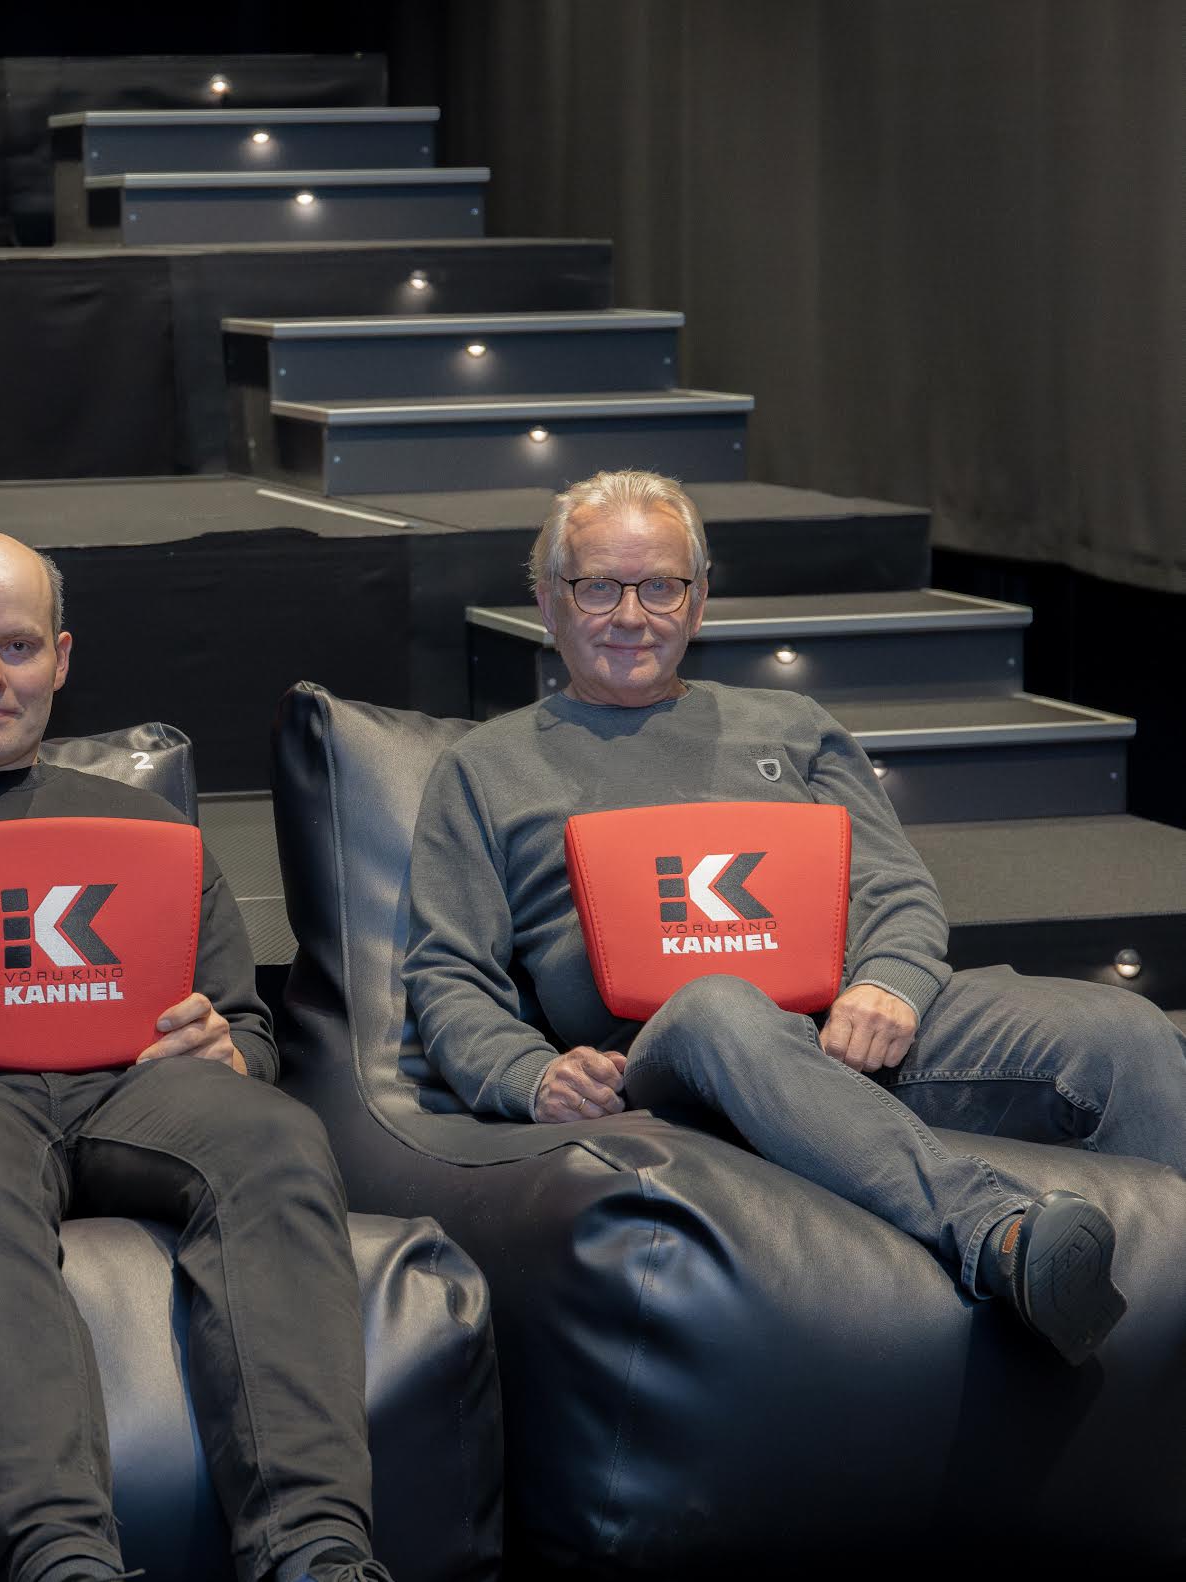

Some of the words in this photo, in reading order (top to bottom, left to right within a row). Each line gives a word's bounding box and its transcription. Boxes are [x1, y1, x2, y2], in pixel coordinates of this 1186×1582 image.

[130, 751, 154, 770] 2
[727, 920, 778, 933] KINO
[661, 932, 779, 955] KANNEL
[72, 967, 124, 980] KINO
[4, 981, 124, 1006] KANNEL
